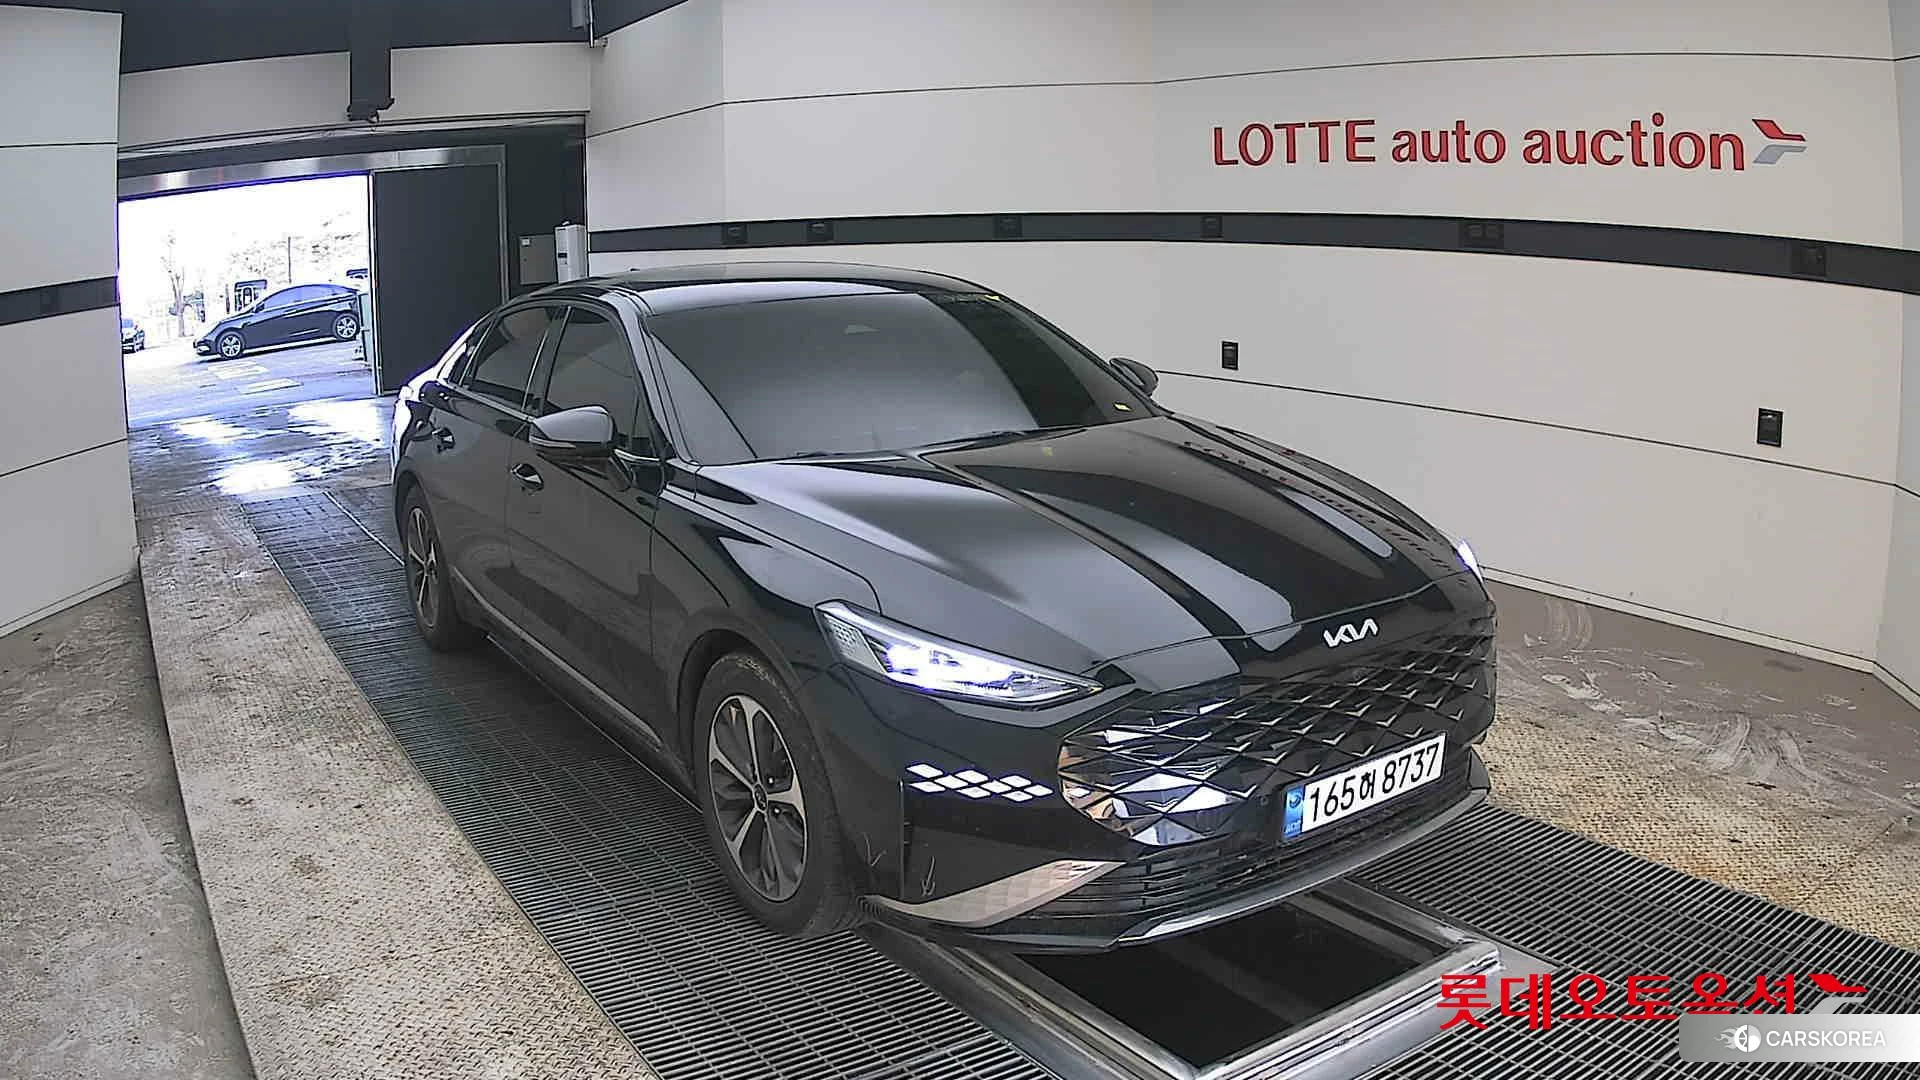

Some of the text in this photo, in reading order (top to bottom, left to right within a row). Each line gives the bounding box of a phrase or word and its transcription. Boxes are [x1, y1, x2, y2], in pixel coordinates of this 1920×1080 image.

[1213, 113, 1746, 172] LOTTE auto auction
[1323, 618, 1379, 648] KIA
[1309, 743, 1441, 822] 165허 8737
